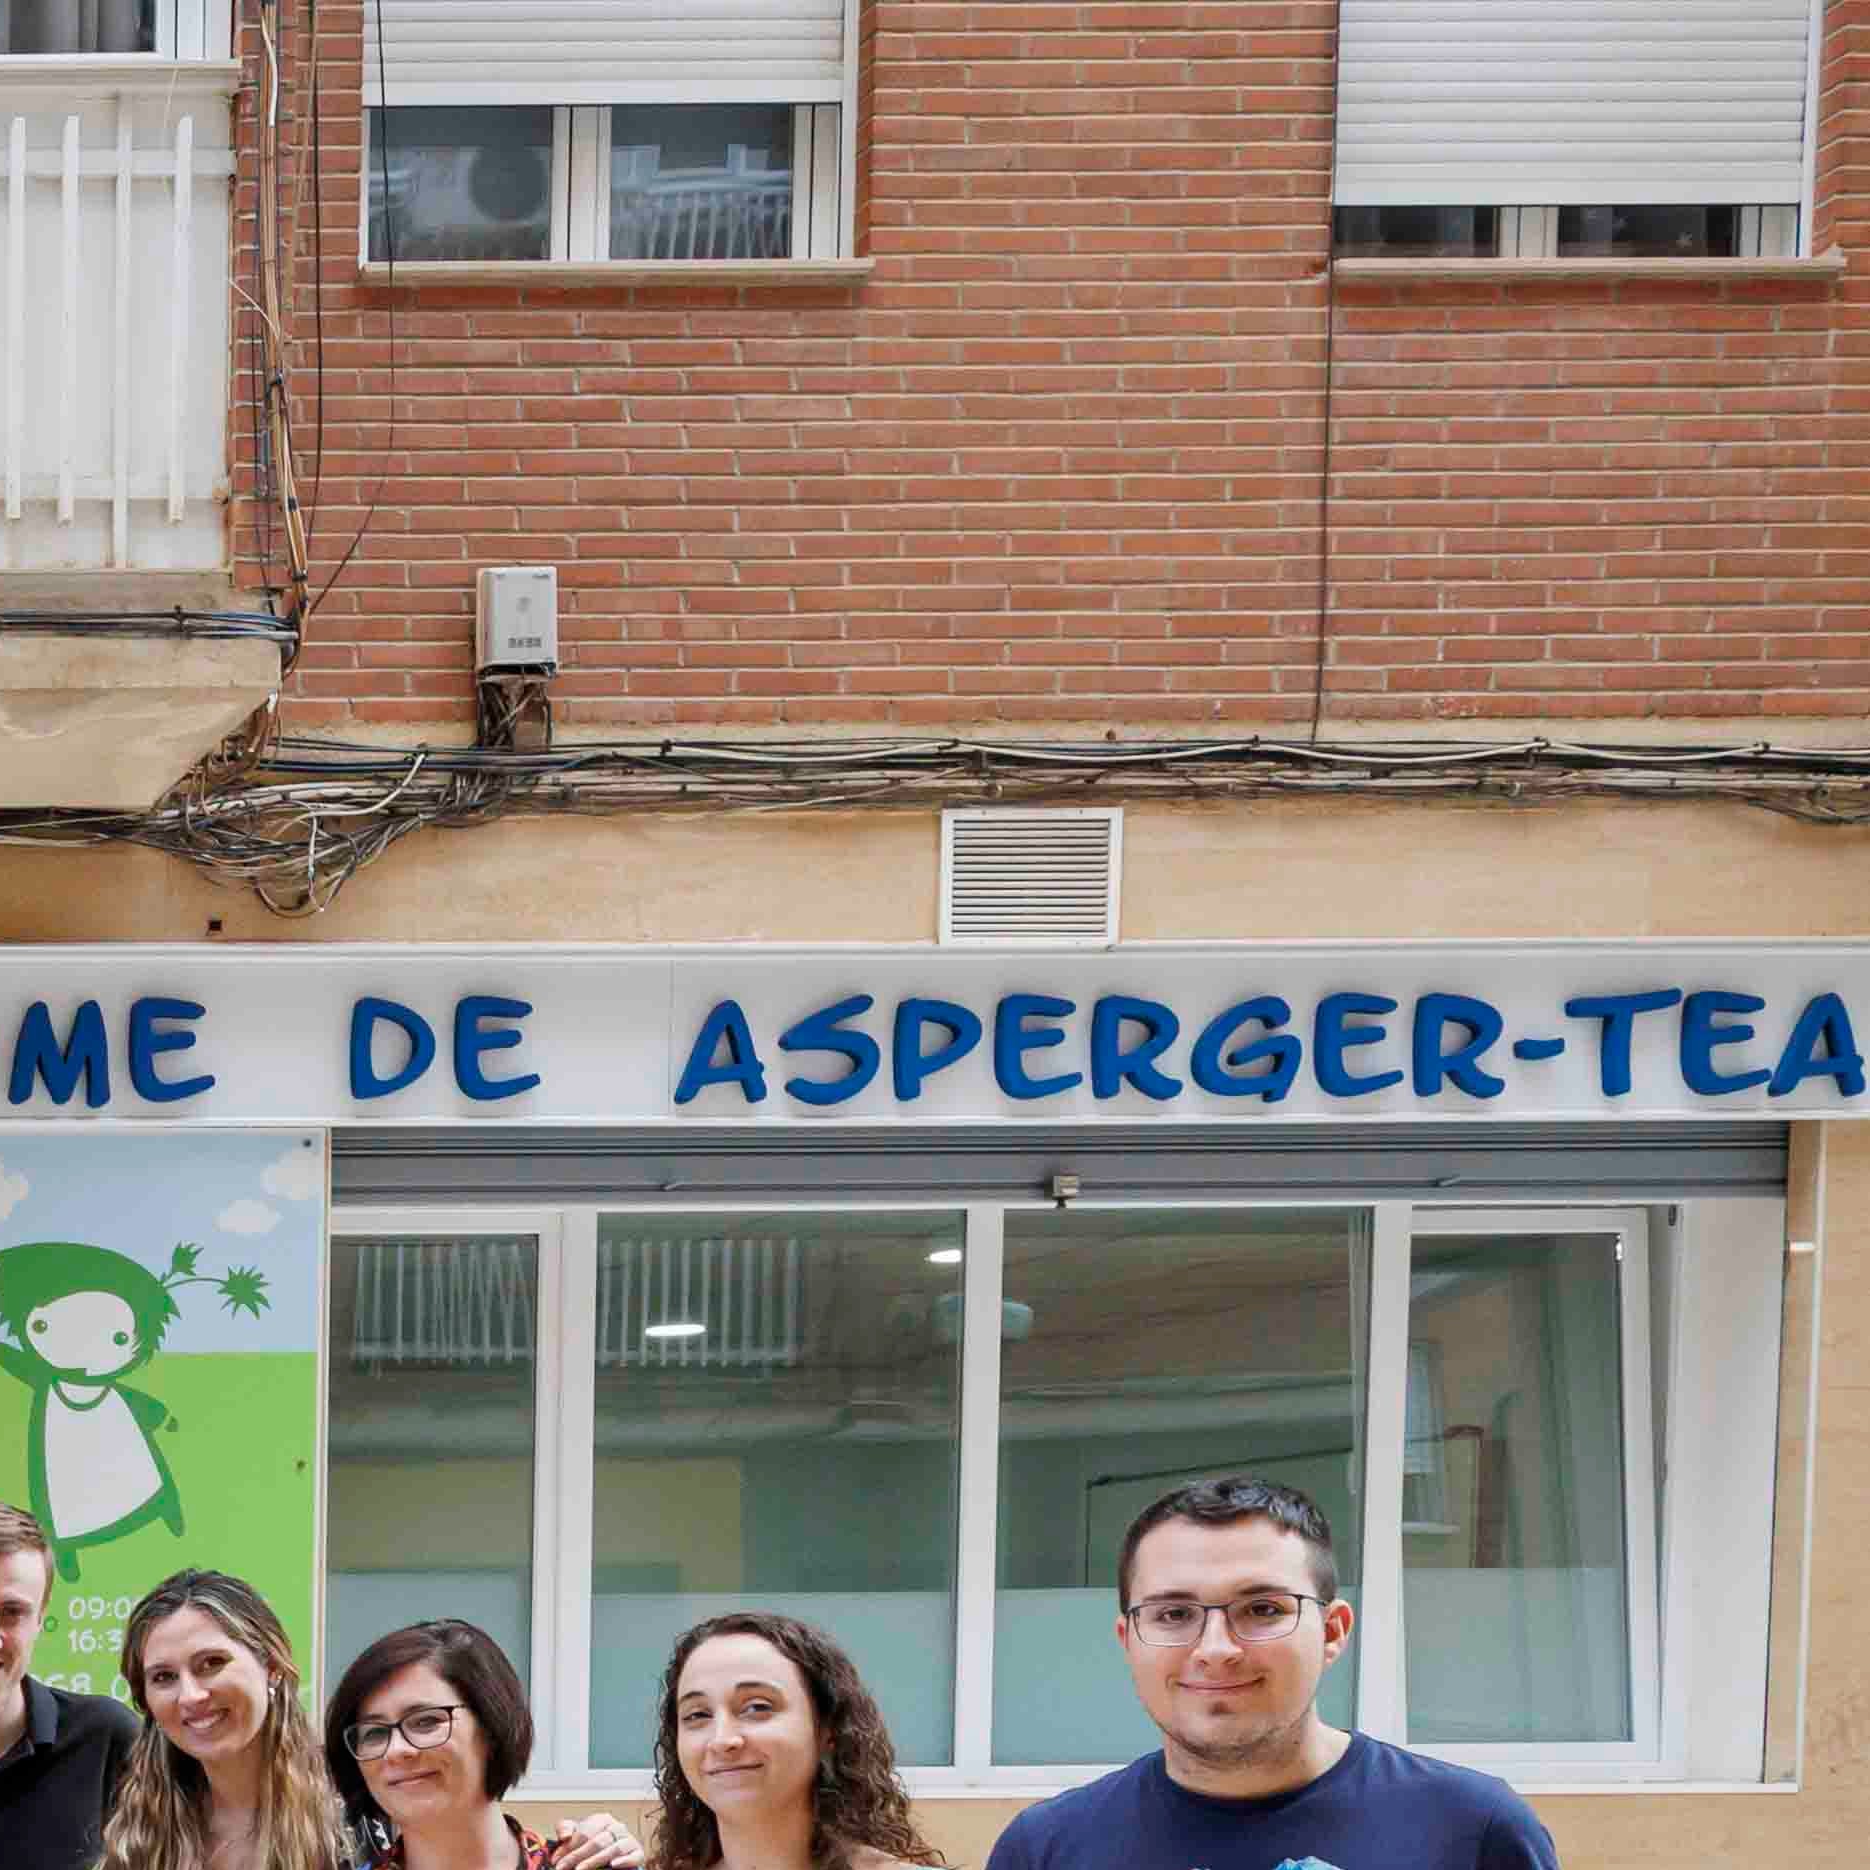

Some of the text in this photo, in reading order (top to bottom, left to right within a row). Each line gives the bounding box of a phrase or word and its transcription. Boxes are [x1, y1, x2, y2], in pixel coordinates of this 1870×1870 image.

[349, 996, 540, 1101] DE
[674, 988, 1867, 1106] ASPERGER-TEA
[69, 1597, 137, 1620] 09:0
